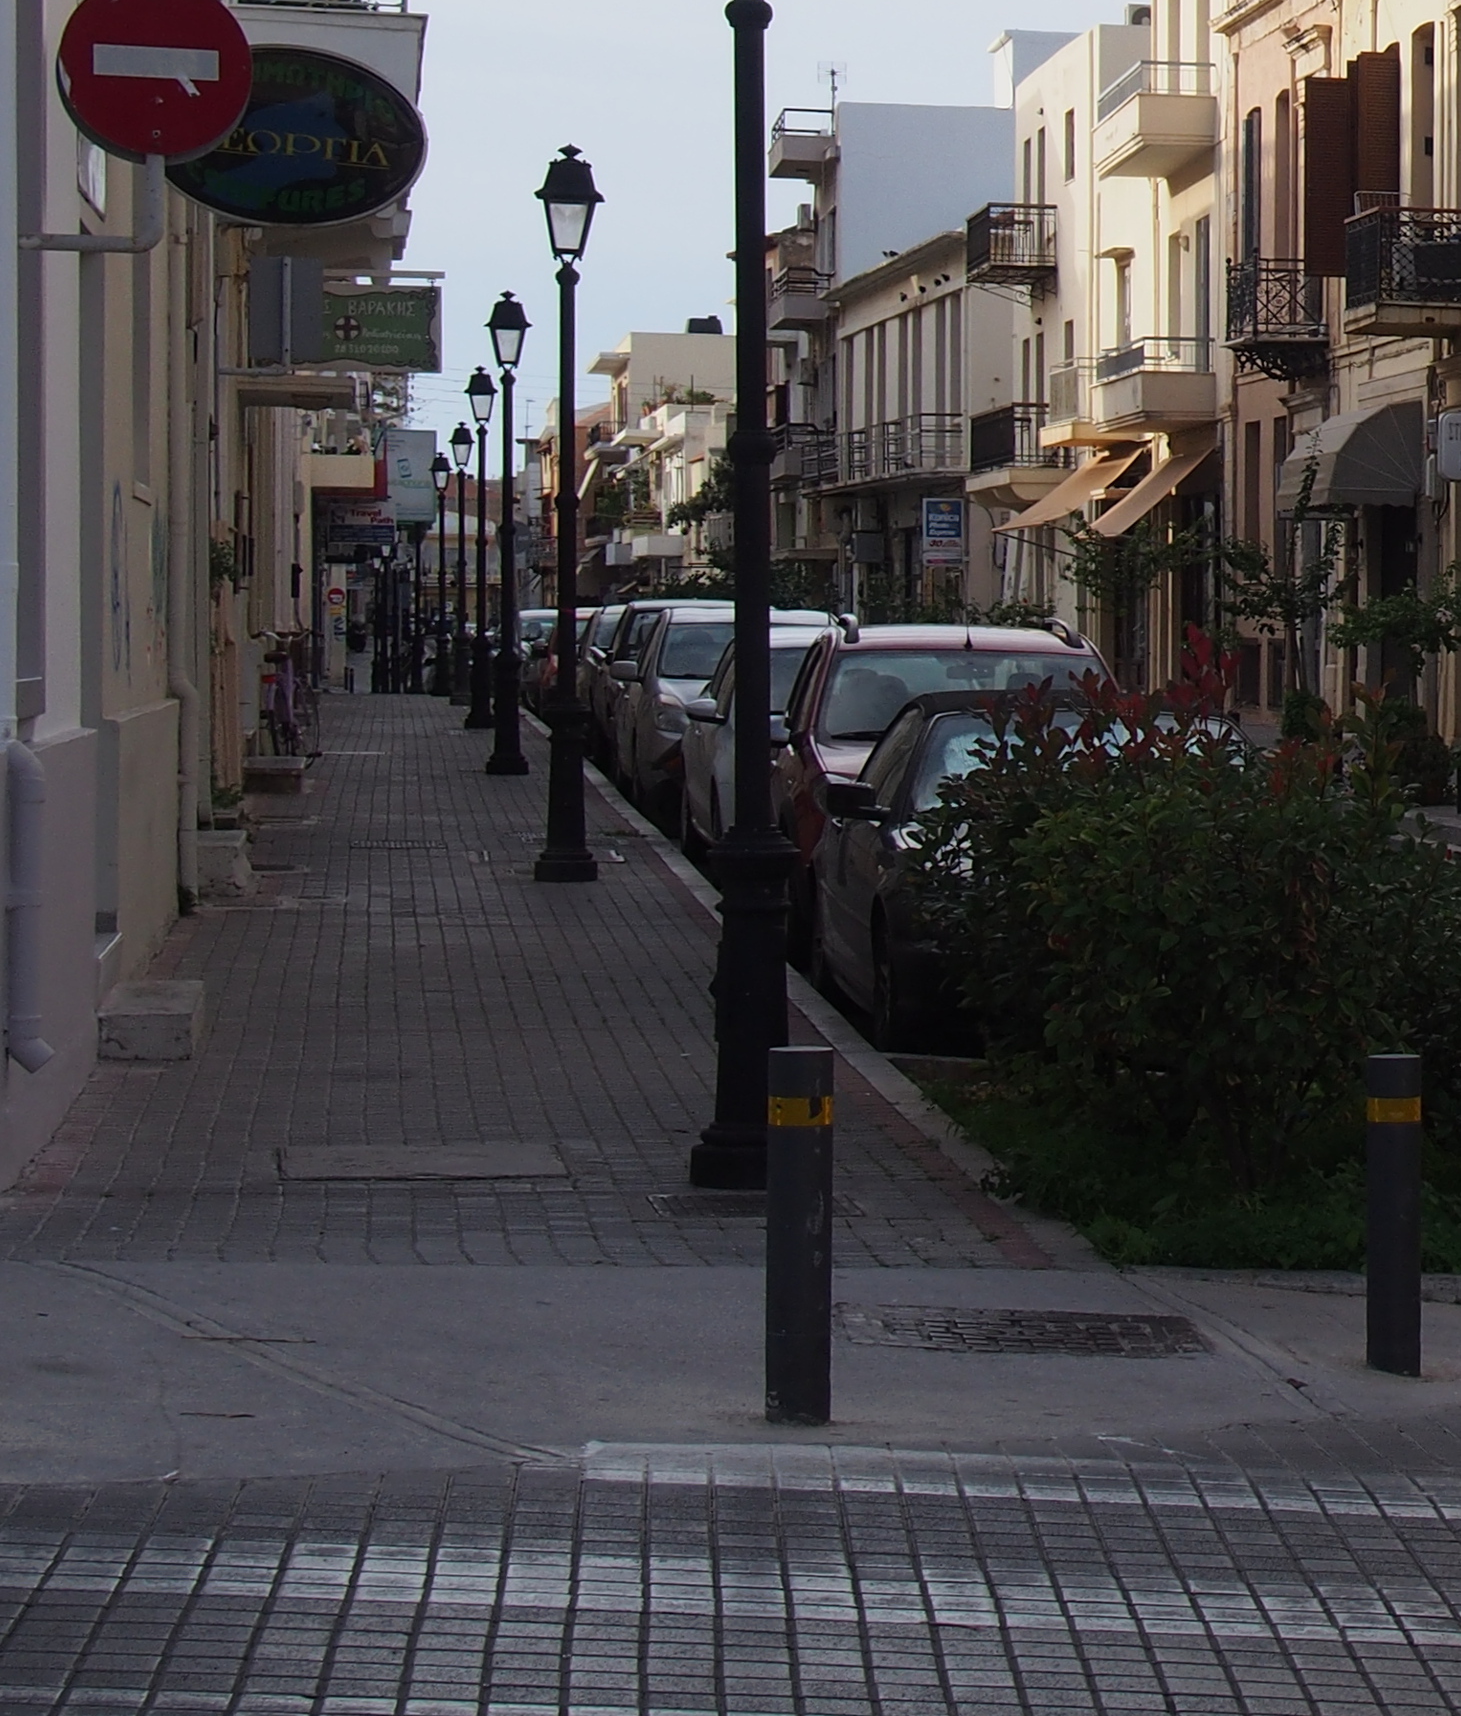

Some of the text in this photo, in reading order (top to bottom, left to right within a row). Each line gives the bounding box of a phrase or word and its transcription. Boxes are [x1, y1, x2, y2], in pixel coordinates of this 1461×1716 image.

[223, 126, 391, 168] ΕΩΡΓΙΑ
[347, 299, 416, 317] ΒΑΡΑΚΗΣ
[349, 508, 382, 517] Travel
[370, 516, 394, 524] Path
